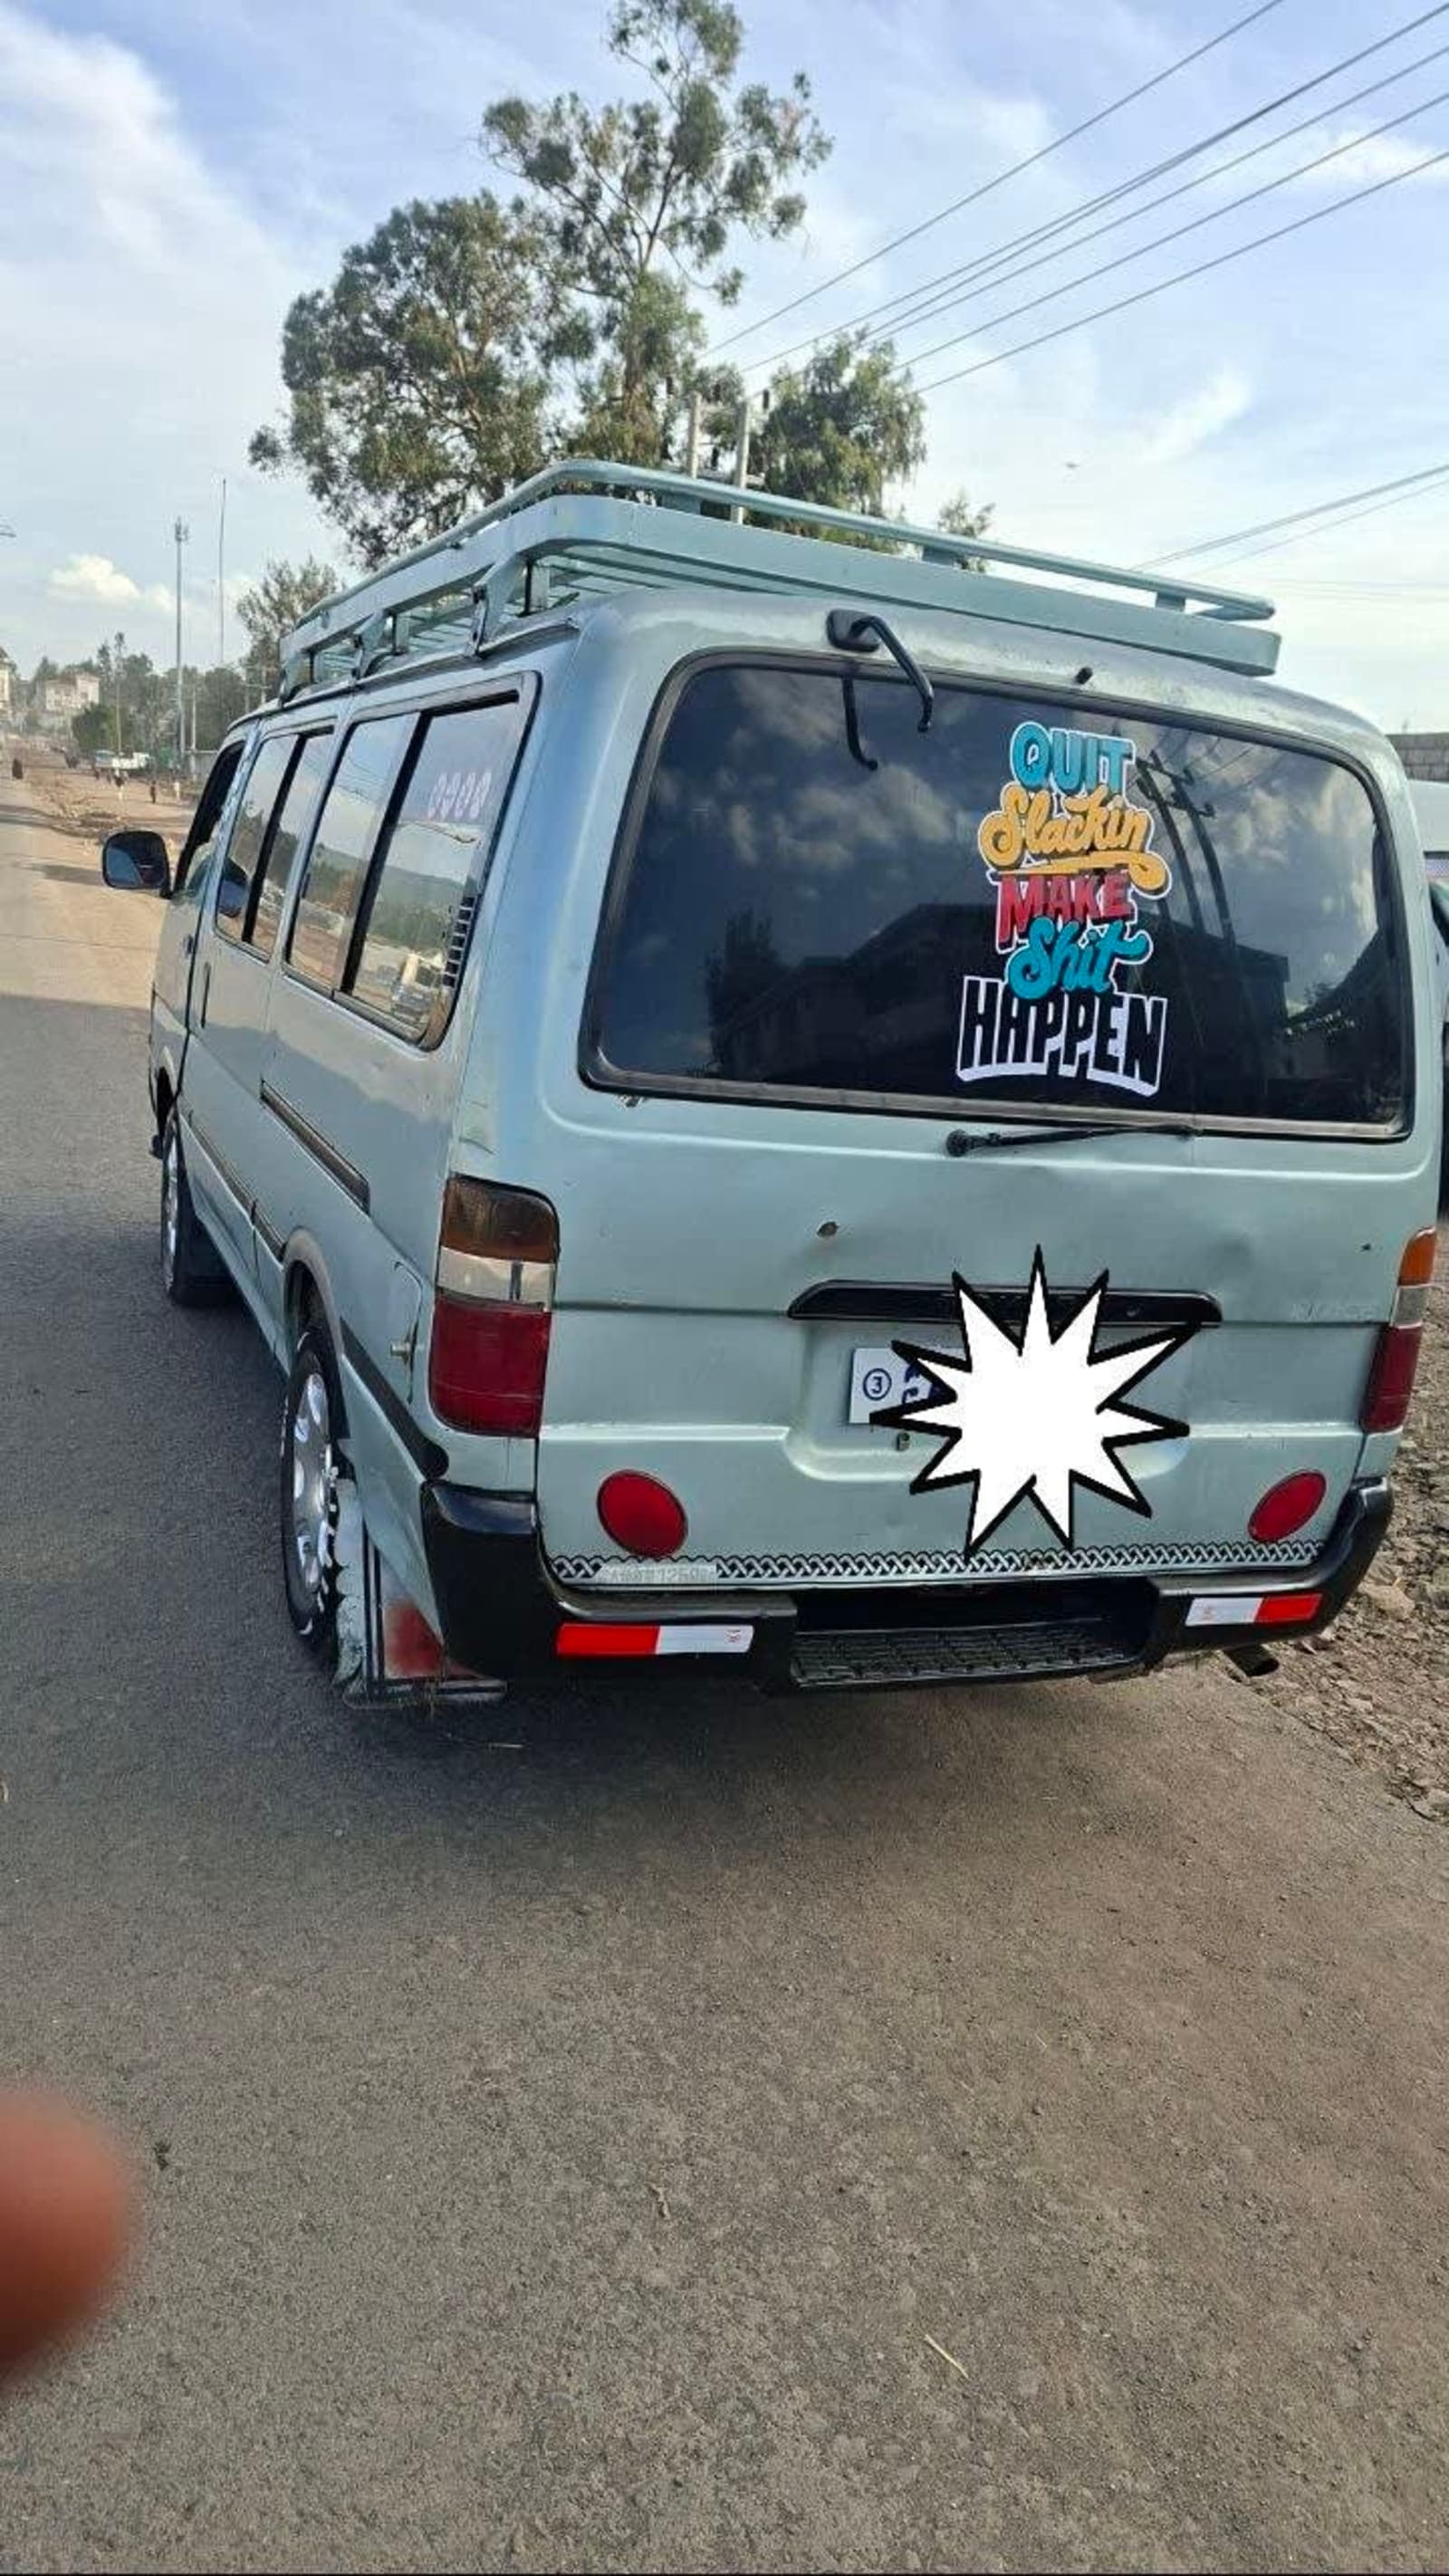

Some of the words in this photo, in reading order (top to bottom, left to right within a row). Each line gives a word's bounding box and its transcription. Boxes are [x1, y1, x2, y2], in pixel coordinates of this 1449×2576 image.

[1011, 722, 1135, 793] QUIT
[997, 872, 1136, 953] MAKE
[1007, 917, 1153, 999] Shit
[957, 976, 1167, 1096] HAPPEN
